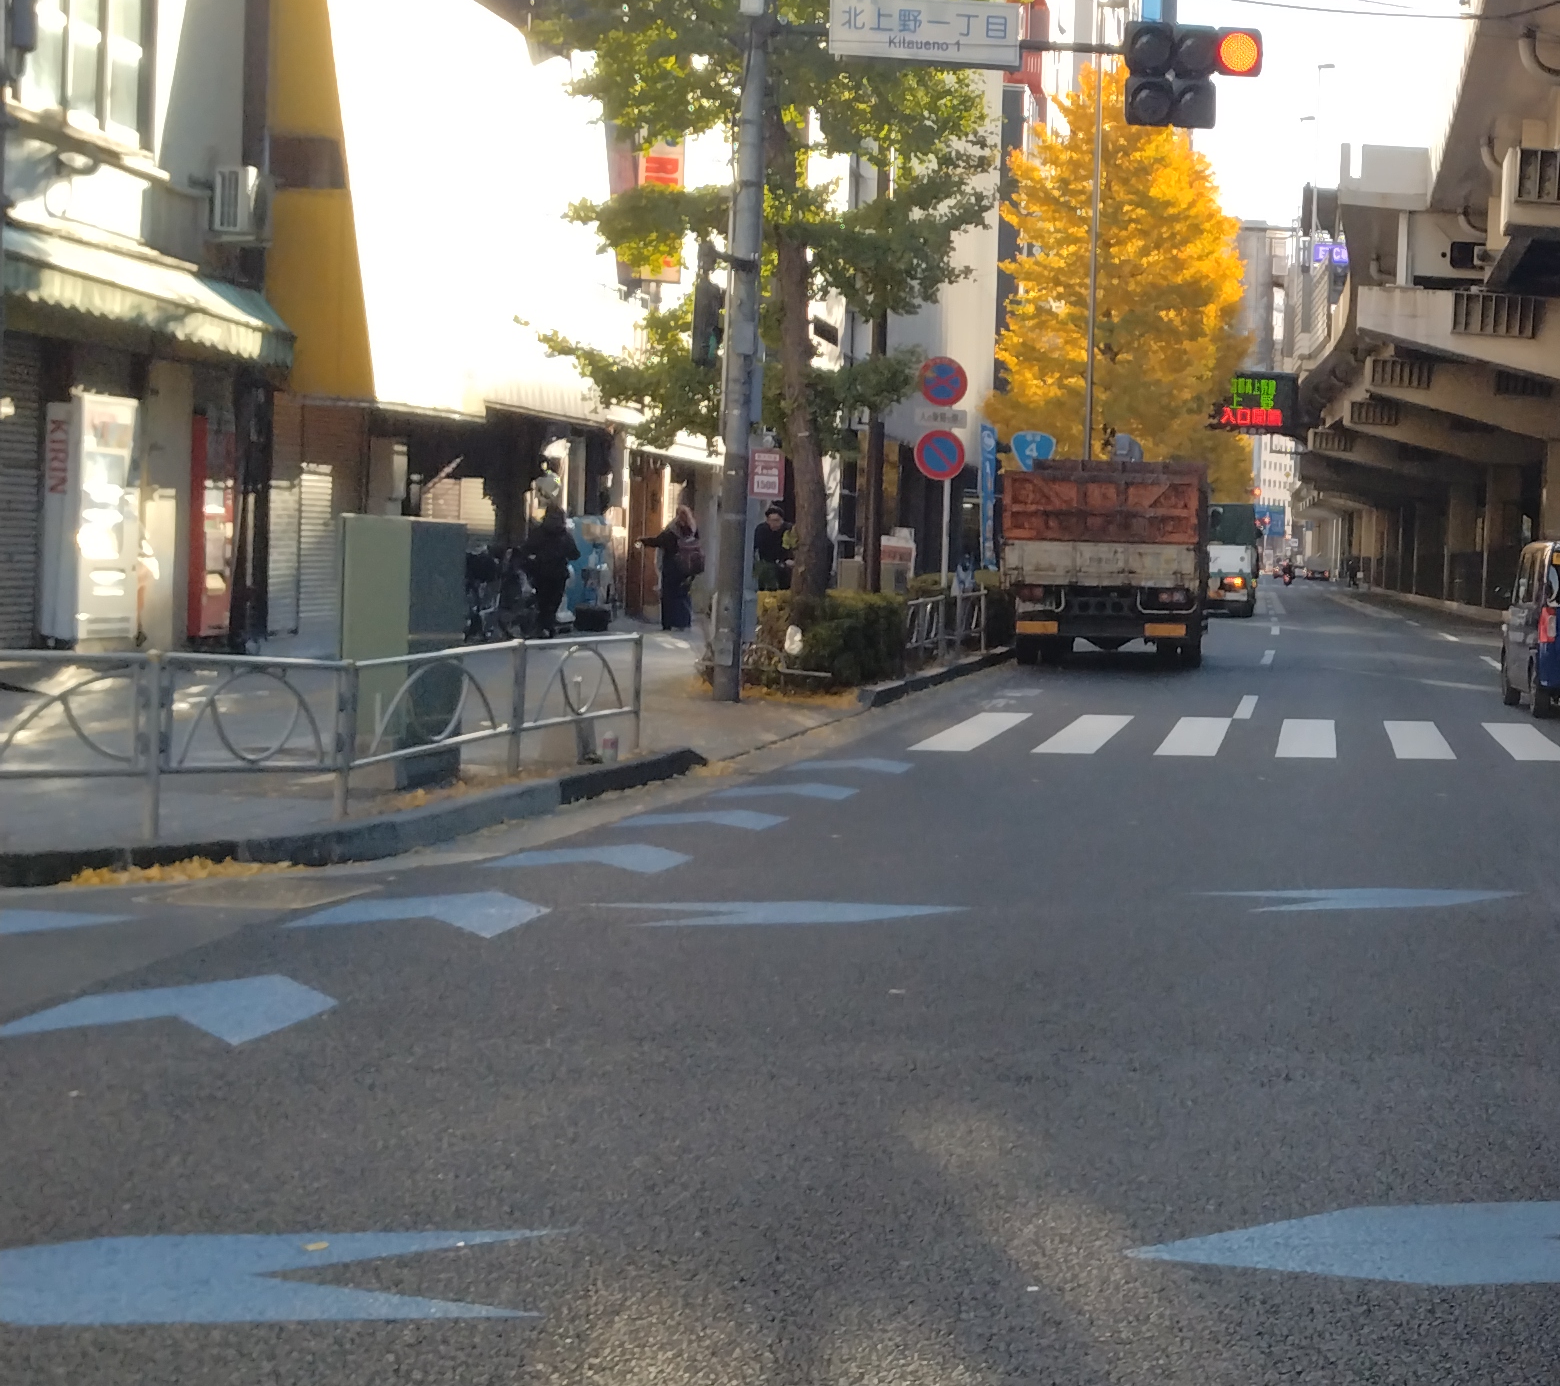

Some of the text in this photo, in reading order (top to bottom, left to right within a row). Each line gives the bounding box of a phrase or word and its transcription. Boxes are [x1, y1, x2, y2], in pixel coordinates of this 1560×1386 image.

[840, 6, 1008, 40] 北上野一丁目
[888, 35, 962, 53] Kitaueno 1
[49, 419, 68, 493] KIRIN
